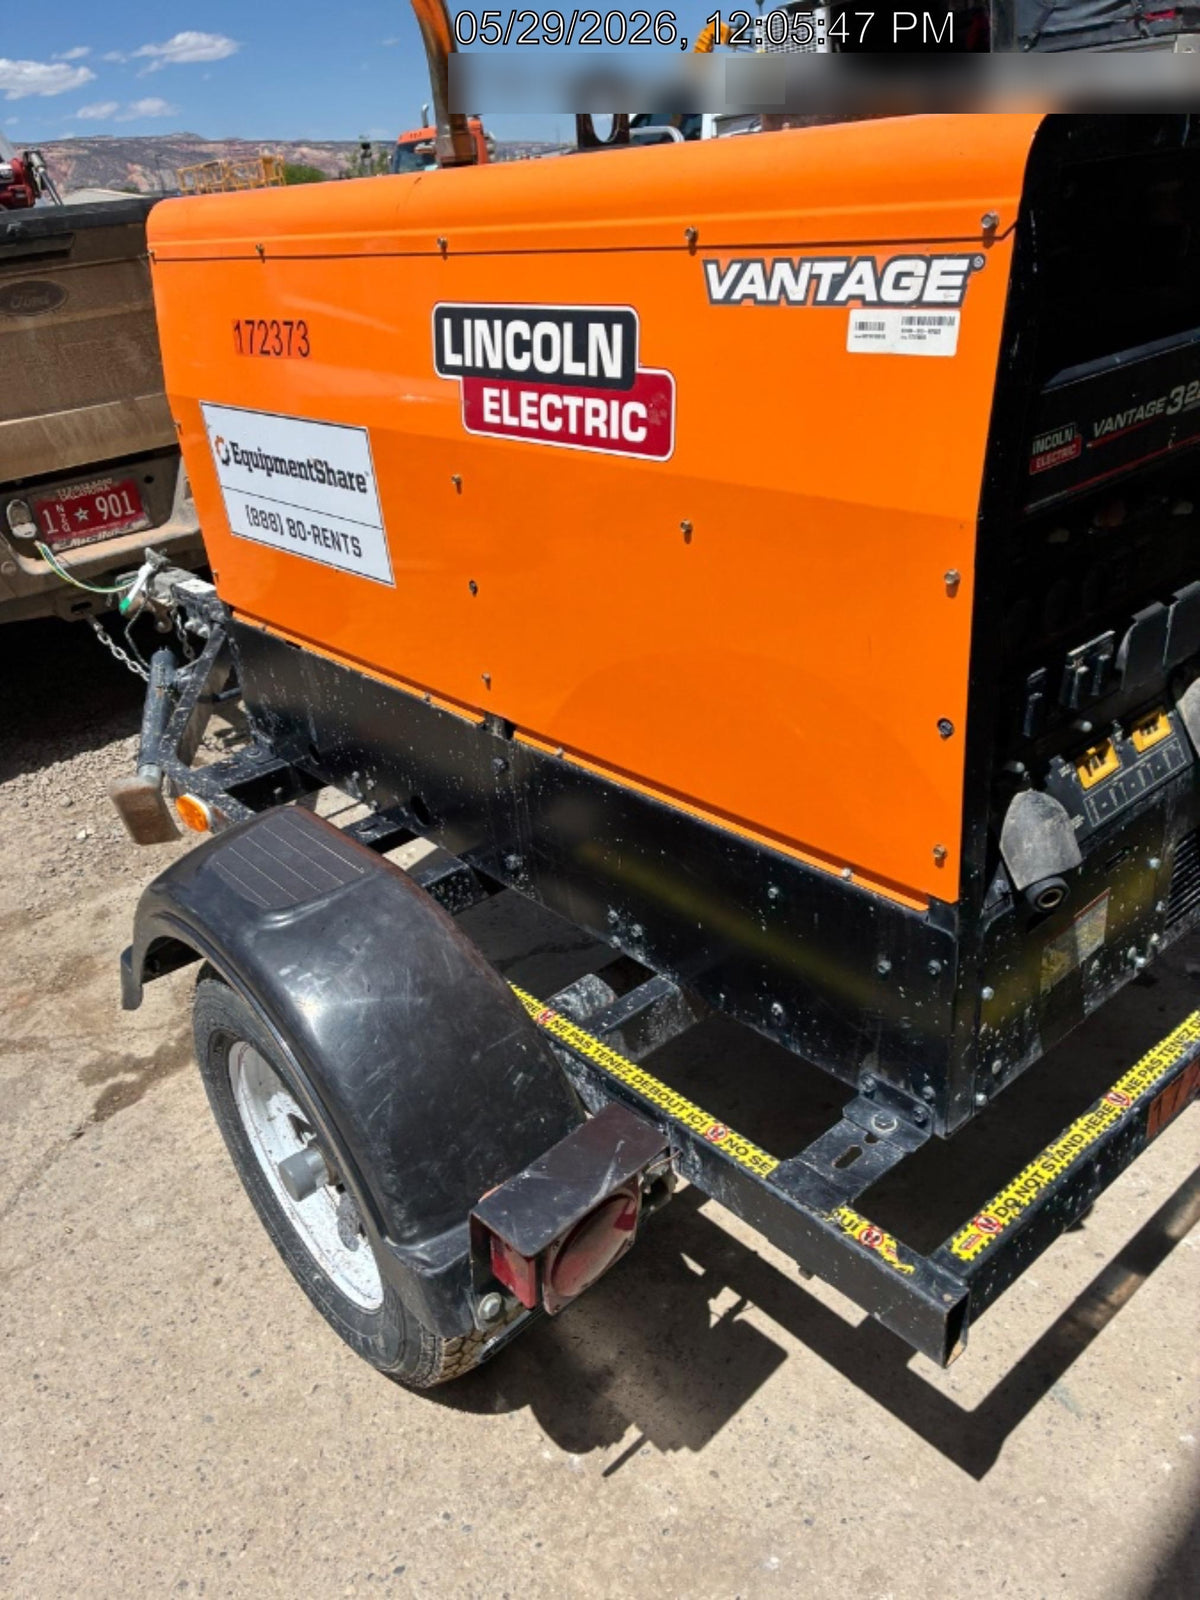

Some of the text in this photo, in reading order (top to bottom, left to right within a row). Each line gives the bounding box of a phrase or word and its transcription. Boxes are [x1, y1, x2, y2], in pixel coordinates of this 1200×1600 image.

[703, 256, 971, 306] VANTAGE
[233, 319, 310, 358] 172373
[443, 317, 624, 380] LINCOLN
[482, 386, 649, 443] ELECTRIC
[1092, 396, 1167, 438] VANTAGE
[229, 441, 368, 494] EquipmentShare
[1035, 444, 1078, 469] ELECTRIC
[42, 508, 59, 535] 1
[94, 489, 136, 520] 901
[245, 505, 363, 559] (888) 80-RENTS
[552, 1020, 709, 1128] NE PAS TENEZ DEBOUT ICI
[1121, 1026, 1194, 1095] NE PAS TENEZ
[724, 1137, 773, 1173] NO SE
[994, 1102, 1116, 1218] DO NOT STAND HERE
